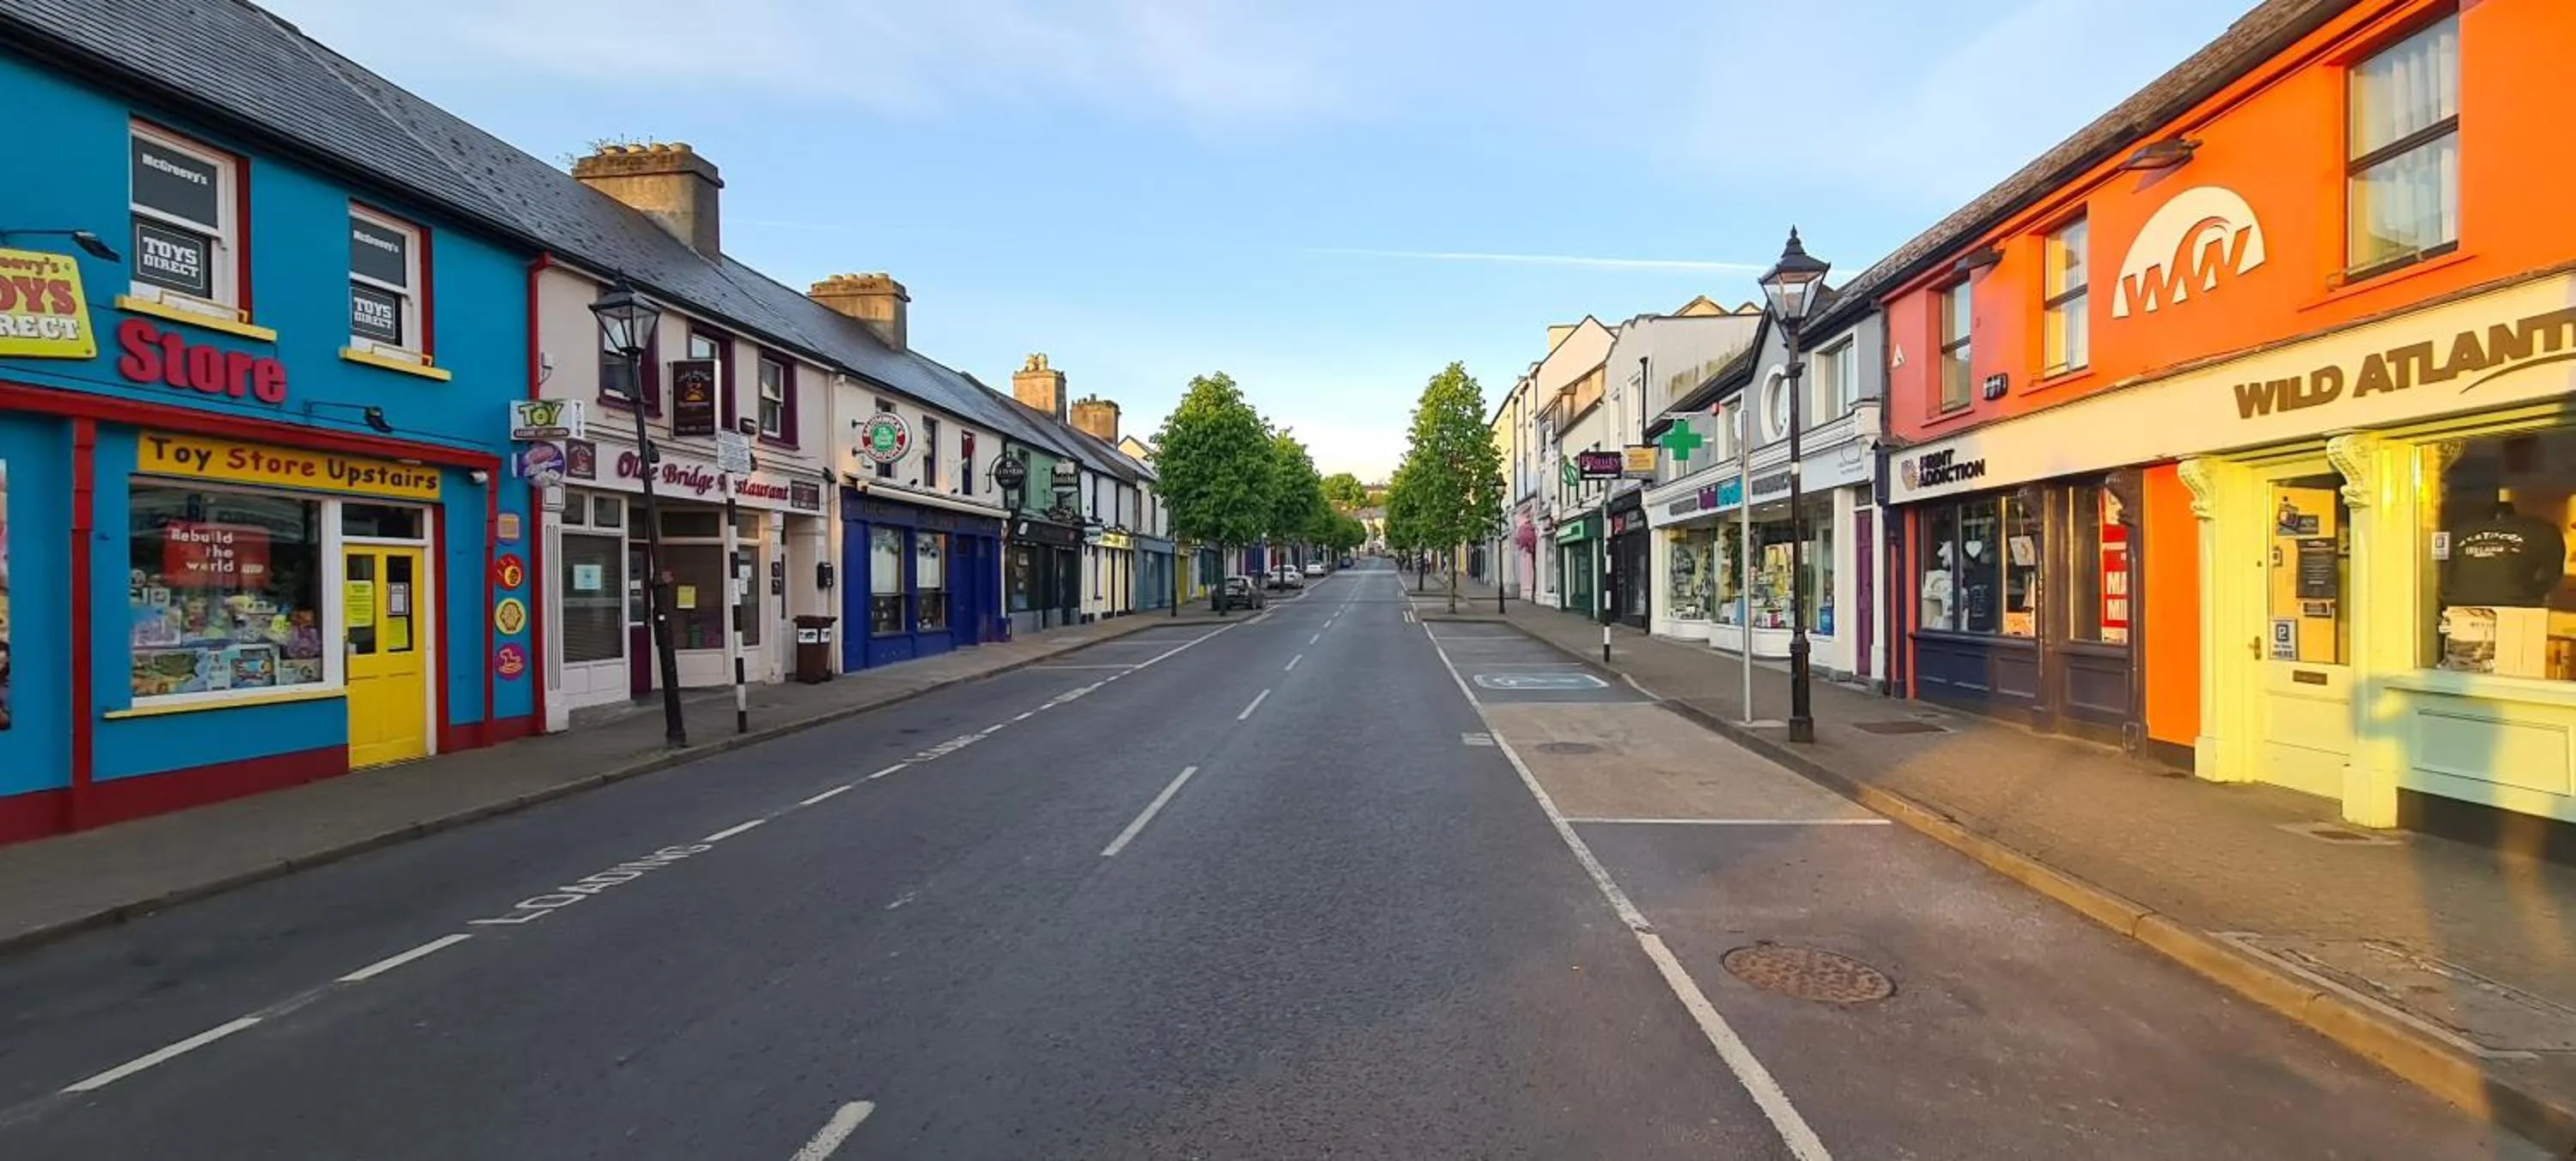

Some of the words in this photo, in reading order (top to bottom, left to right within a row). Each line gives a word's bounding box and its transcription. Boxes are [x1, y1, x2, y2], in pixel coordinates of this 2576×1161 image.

[143, 236, 198, 265] TOYS
[143, 253, 200, 278] DIRECT
[354, 296, 392, 319] TOYS
[354, 311, 392, 329] DIRECT
[118, 316, 287, 404] Store
[2233, 364, 2345, 420] WILD
[2353, 307, 2576, 398] ATLANT
[518, 401, 564, 427] TOY
[148, 435, 212, 471] Toy
[227, 447, 317, 478] Store
[328, 457, 439, 490] Upstairs
[1919, 448, 1955, 471] PRINT
[662, 463, 714, 496] Bridge
[1917, 458, 1986, 488] ADDICTION
[171, 527, 234, 544] Rebuild
[205, 544, 234, 559] the
[185, 560, 234, 574] world
[467, 845, 714, 926] LOADING
